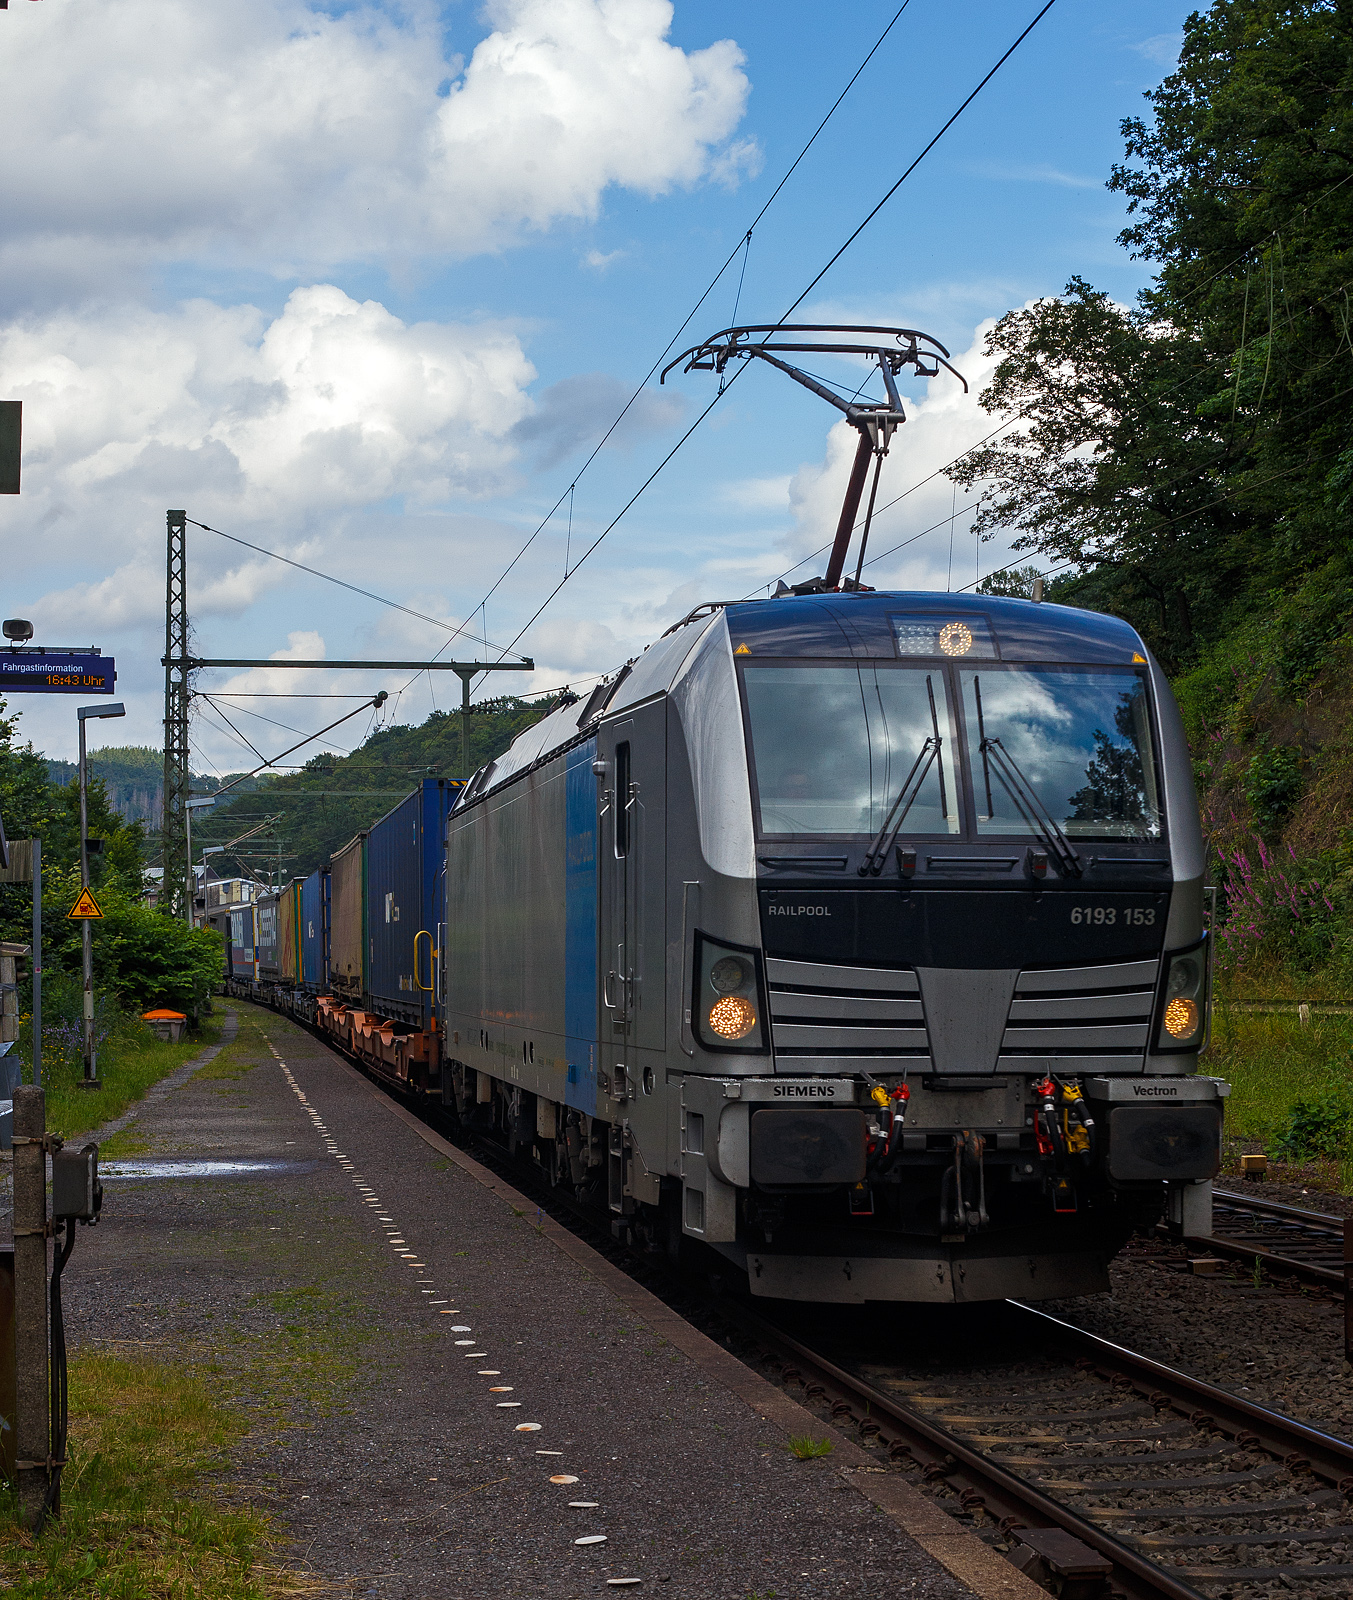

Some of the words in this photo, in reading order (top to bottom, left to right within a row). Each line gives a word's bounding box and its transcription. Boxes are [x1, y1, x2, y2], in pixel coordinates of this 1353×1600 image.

[2, 663, 83, 673] Fahrgastinformation
[46, 675, 79, 685] 16:43
[83, 676, 105, 686] Uhr
[768, 906, 831, 916] RAILPOOL
[1071, 907, 1117, 925] 6193
[1123, 908, 1156, 926] 153
[773, 1085, 835, 1097] SIEMENS
[1133, 1085, 1177, 1096] Vectron
